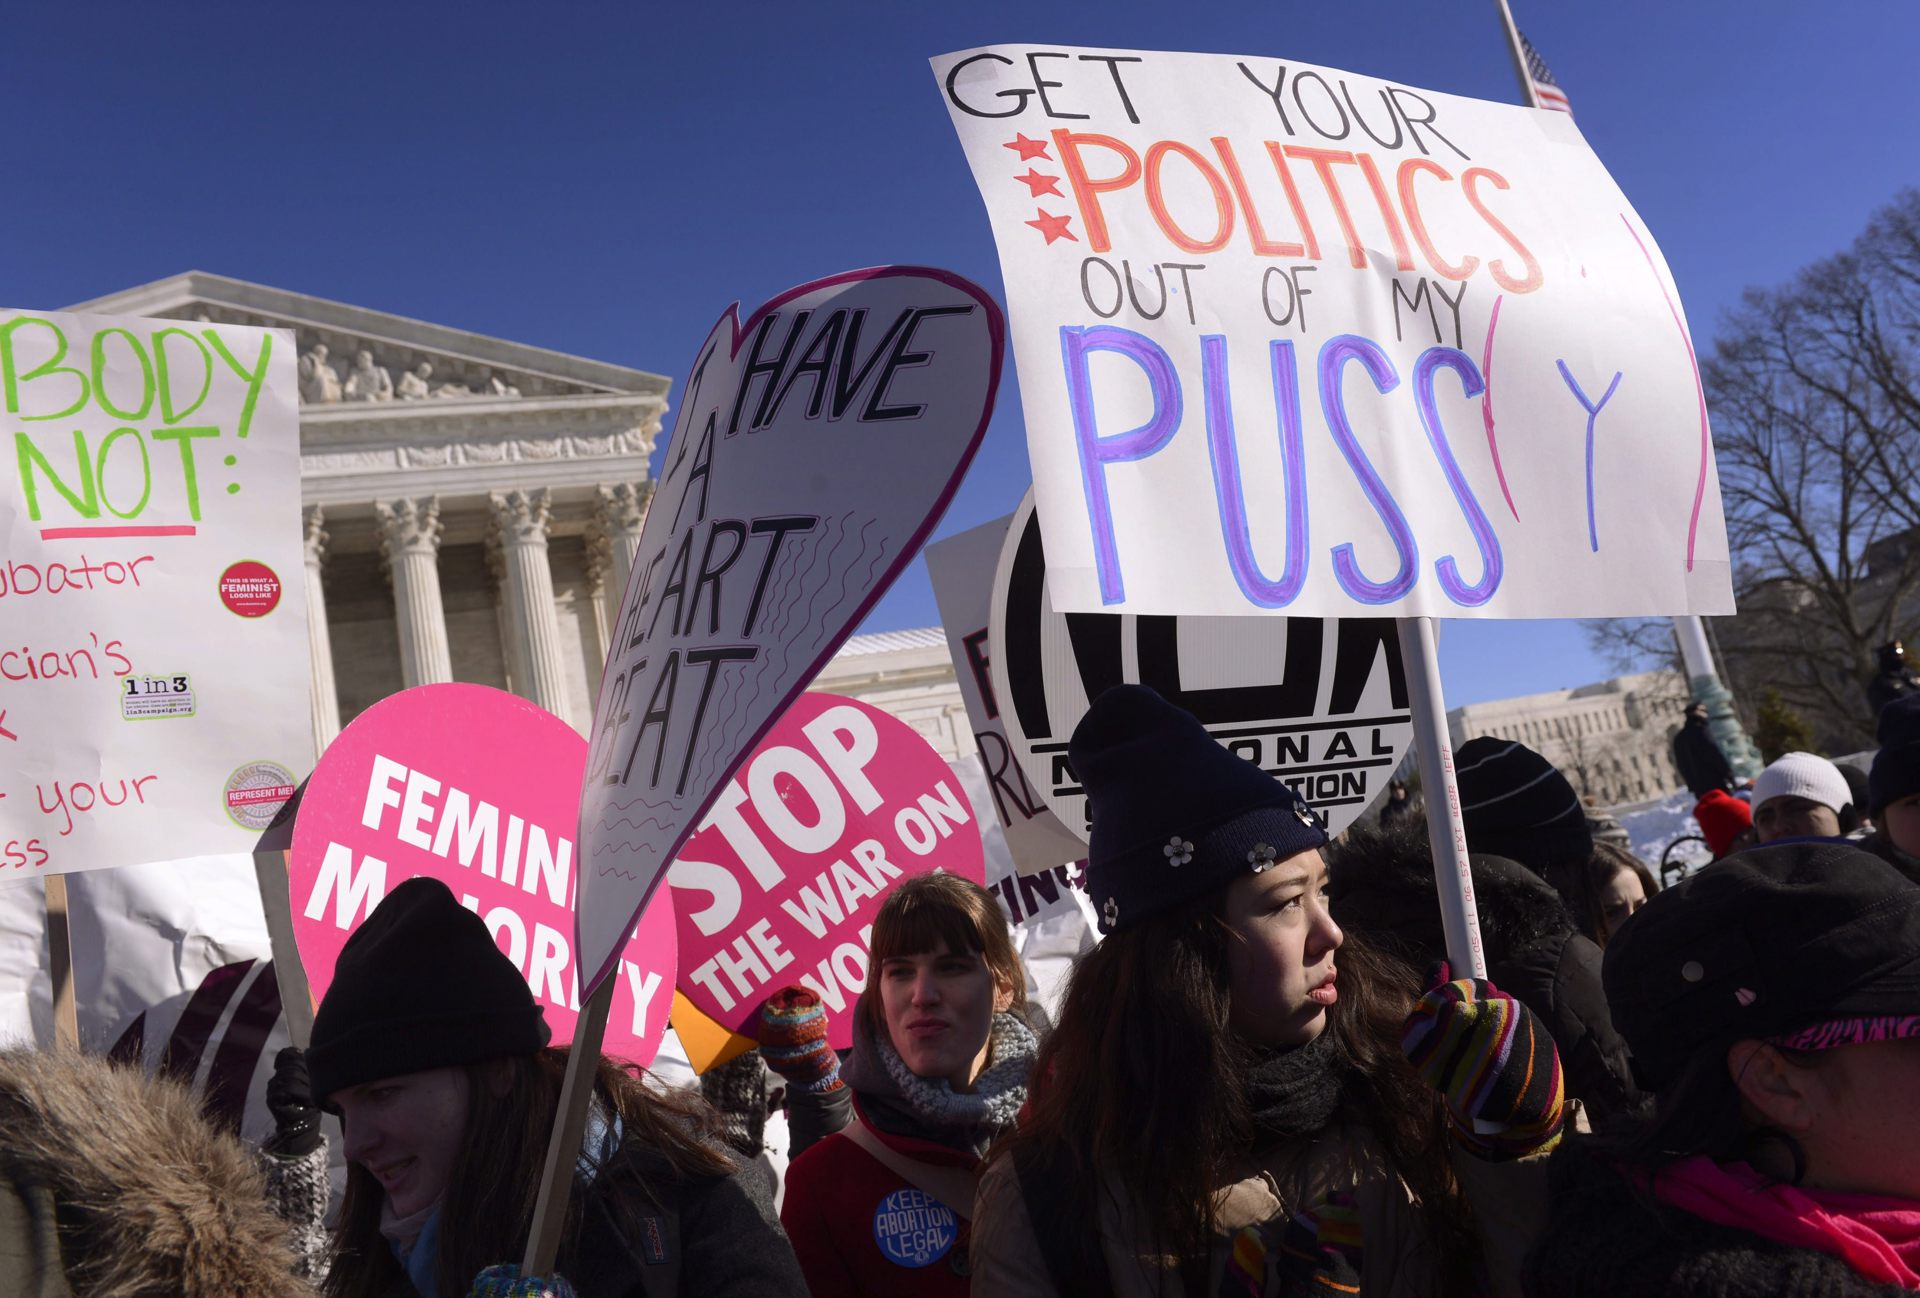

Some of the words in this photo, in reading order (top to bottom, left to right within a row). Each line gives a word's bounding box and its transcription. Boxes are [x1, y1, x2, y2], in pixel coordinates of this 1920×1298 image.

[946, 52, 1142, 124] GET
[1236, 62, 1471, 160] YOUR
[1049, 128, 1544, 295] POLITICS
[1080, 257, 1206, 324] OUT
[1262, 266, 1317, 334] OF
[1392, 278, 1468, 349] MY
[0, 316, 272, 438] BODY
[724, 304, 978, 439] HAVE
[15, 426, 241, 521] NOT:
[669, 406, 719, 538] A
[221, 584, 278, 592] FEMINIST
[615, 515, 820, 664] HEART
[0, 632, 132, 680] cian's
[126, 679, 139, 695] 1
[144, 677, 170, 694] in
[173, 676, 187, 692] 3
[587, 644, 760, 800] BEAT
[1052, 729, 1394, 785] NONAL
[36, 775, 158, 835] your
[230, 788, 276, 801] REPRESENT
[278, 787, 293, 796] ME!
[668, 705, 884, 936] STOP
[689, 917, 796, 1012] THE
[780, 839, 903, 940] WAR
[894, 780, 970, 856] ON
[876, 1208, 953, 1238] ABORTION
[886, 1189, 935, 1211] KEEP
[887, 1228, 950, 1258] LEGAL
